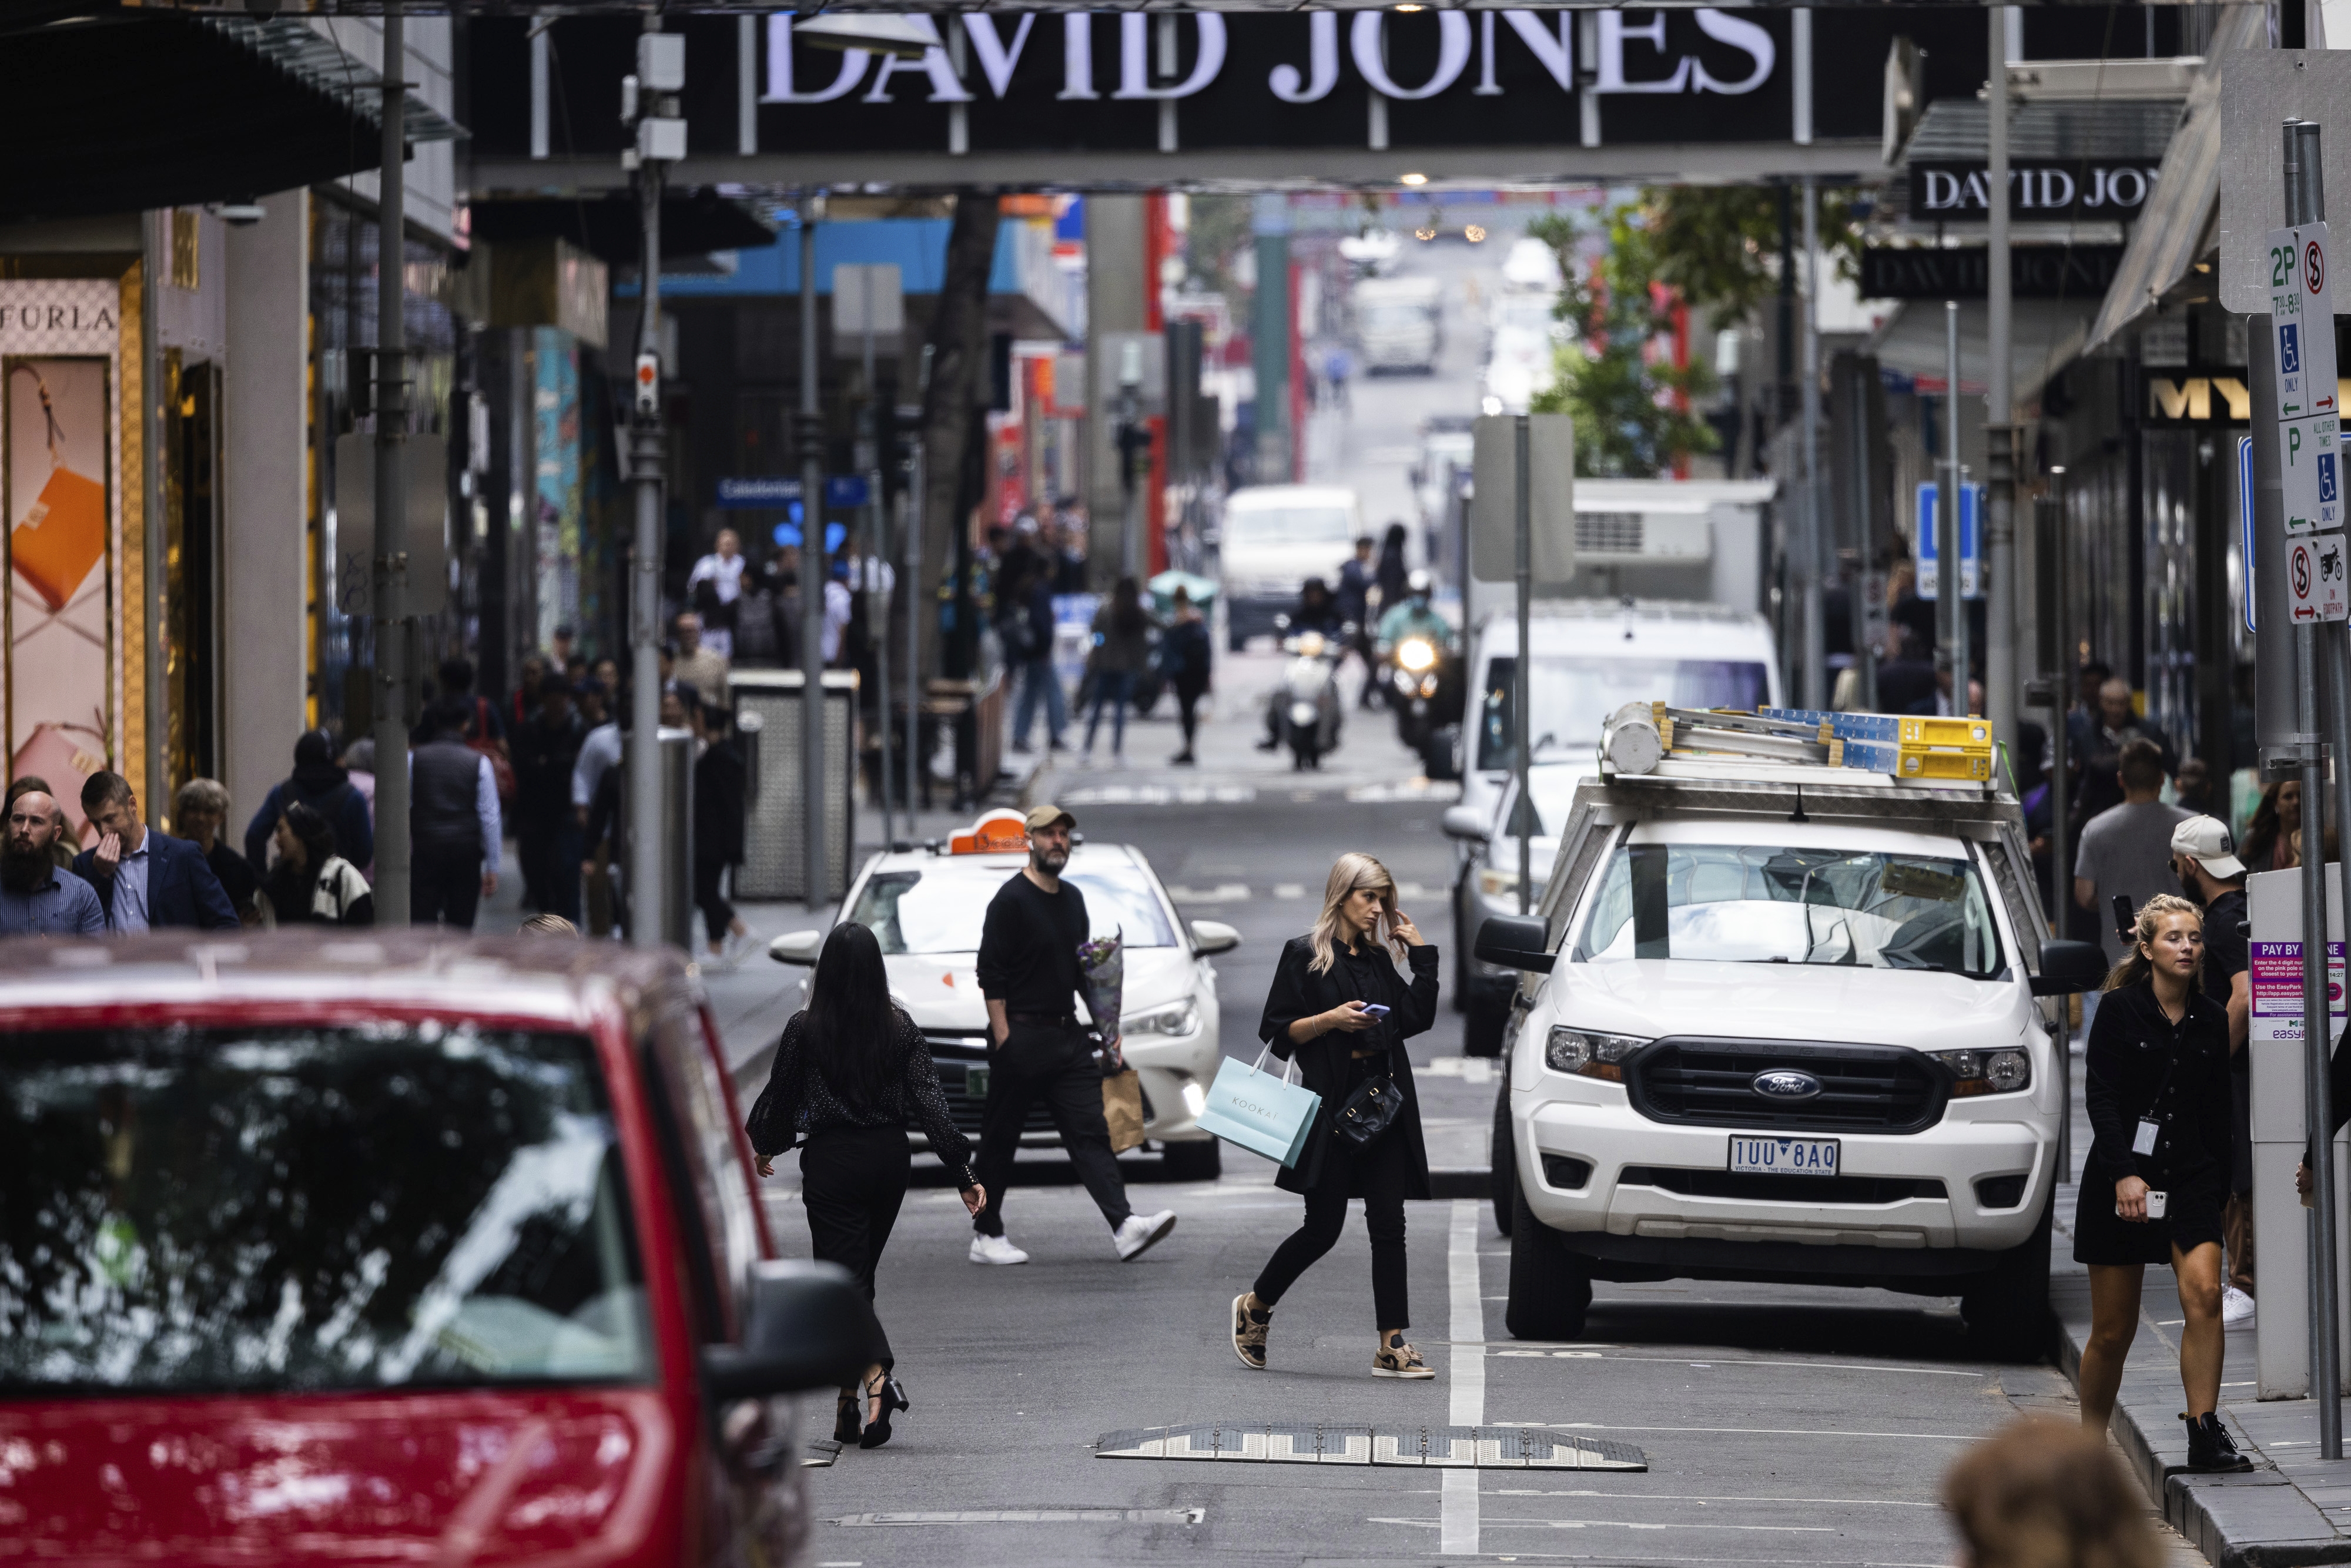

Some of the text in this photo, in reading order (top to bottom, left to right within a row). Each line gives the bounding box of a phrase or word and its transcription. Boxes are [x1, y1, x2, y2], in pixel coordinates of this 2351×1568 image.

[758, 9, 1776, 104] DAVID JONES
[1923, 168, 2075, 209] DAID
[2270, 245, 2295, 287] 2P
[0, 304, 115, 331] FURLA
[2285, 377, 2298, 393] ONLY
[2313, 420, 2335, 434] ALL OTHER
[2289, 426, 2300, 467] P
[2319, 435, 2331, 448] TIMES
[2322, 506, 2335, 522] ONLY
[2329, 588, 2335, 600] ON
[2323, 602, 2343, 615] FOOTPATH
[974, 832, 1026, 850] 13cab
[2262, 944, 2283, 955] PAY
[2285, 944, 2299, 955] BY
[1768, 1076, 1805, 1093] Ford
[1737, 1141, 1774, 1165] 1UU
[1794, 1144, 1834, 1168] 8AQ
